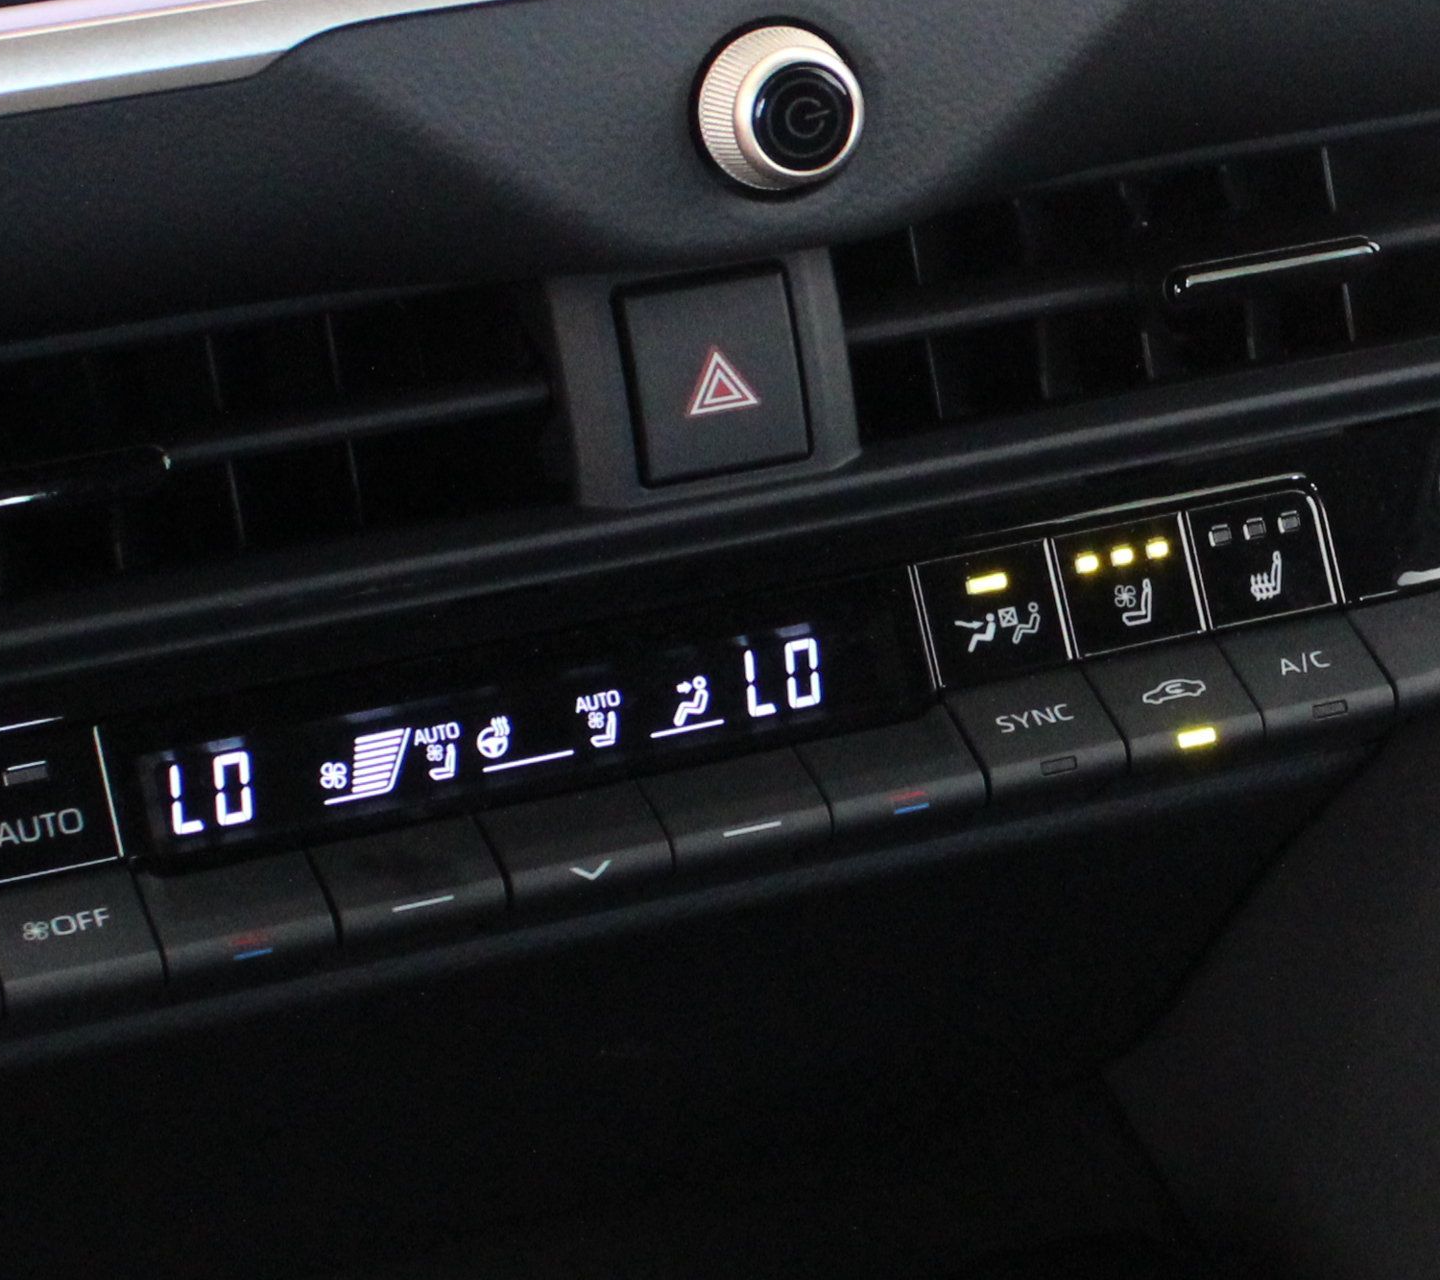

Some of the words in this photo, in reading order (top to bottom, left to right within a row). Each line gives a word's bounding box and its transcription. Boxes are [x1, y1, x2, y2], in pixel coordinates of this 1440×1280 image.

[1278, 646, 1332, 679] A/C
[574, 687, 622, 715] AUTO
[994, 700, 1075, 735] SYNC
[413, 720, 462, 747] AUTO
[51, 906, 111, 939] OFF
